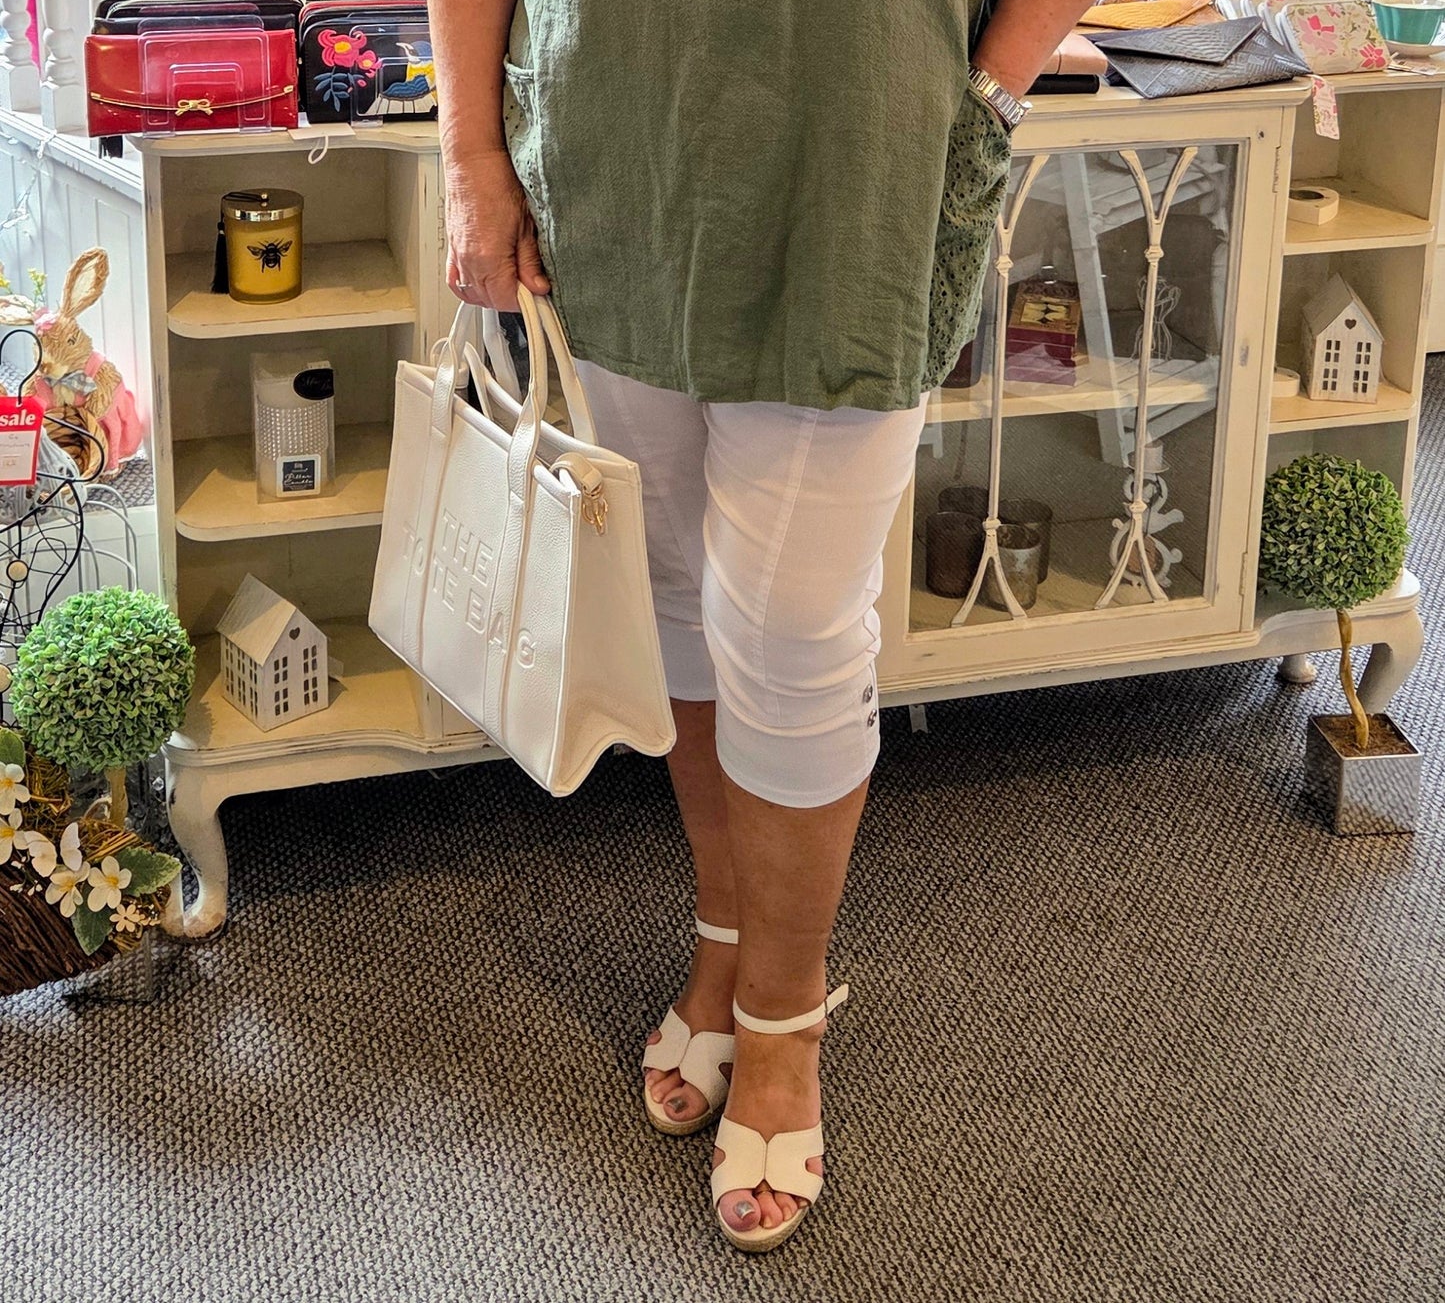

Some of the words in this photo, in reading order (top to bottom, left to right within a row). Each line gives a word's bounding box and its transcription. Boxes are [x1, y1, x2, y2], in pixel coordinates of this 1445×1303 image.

[0, 409, 36, 427] sale
[443, 508, 494, 587] THE
[403, 521, 458, 615] TOTE
[465, 588, 537, 669] BAG
